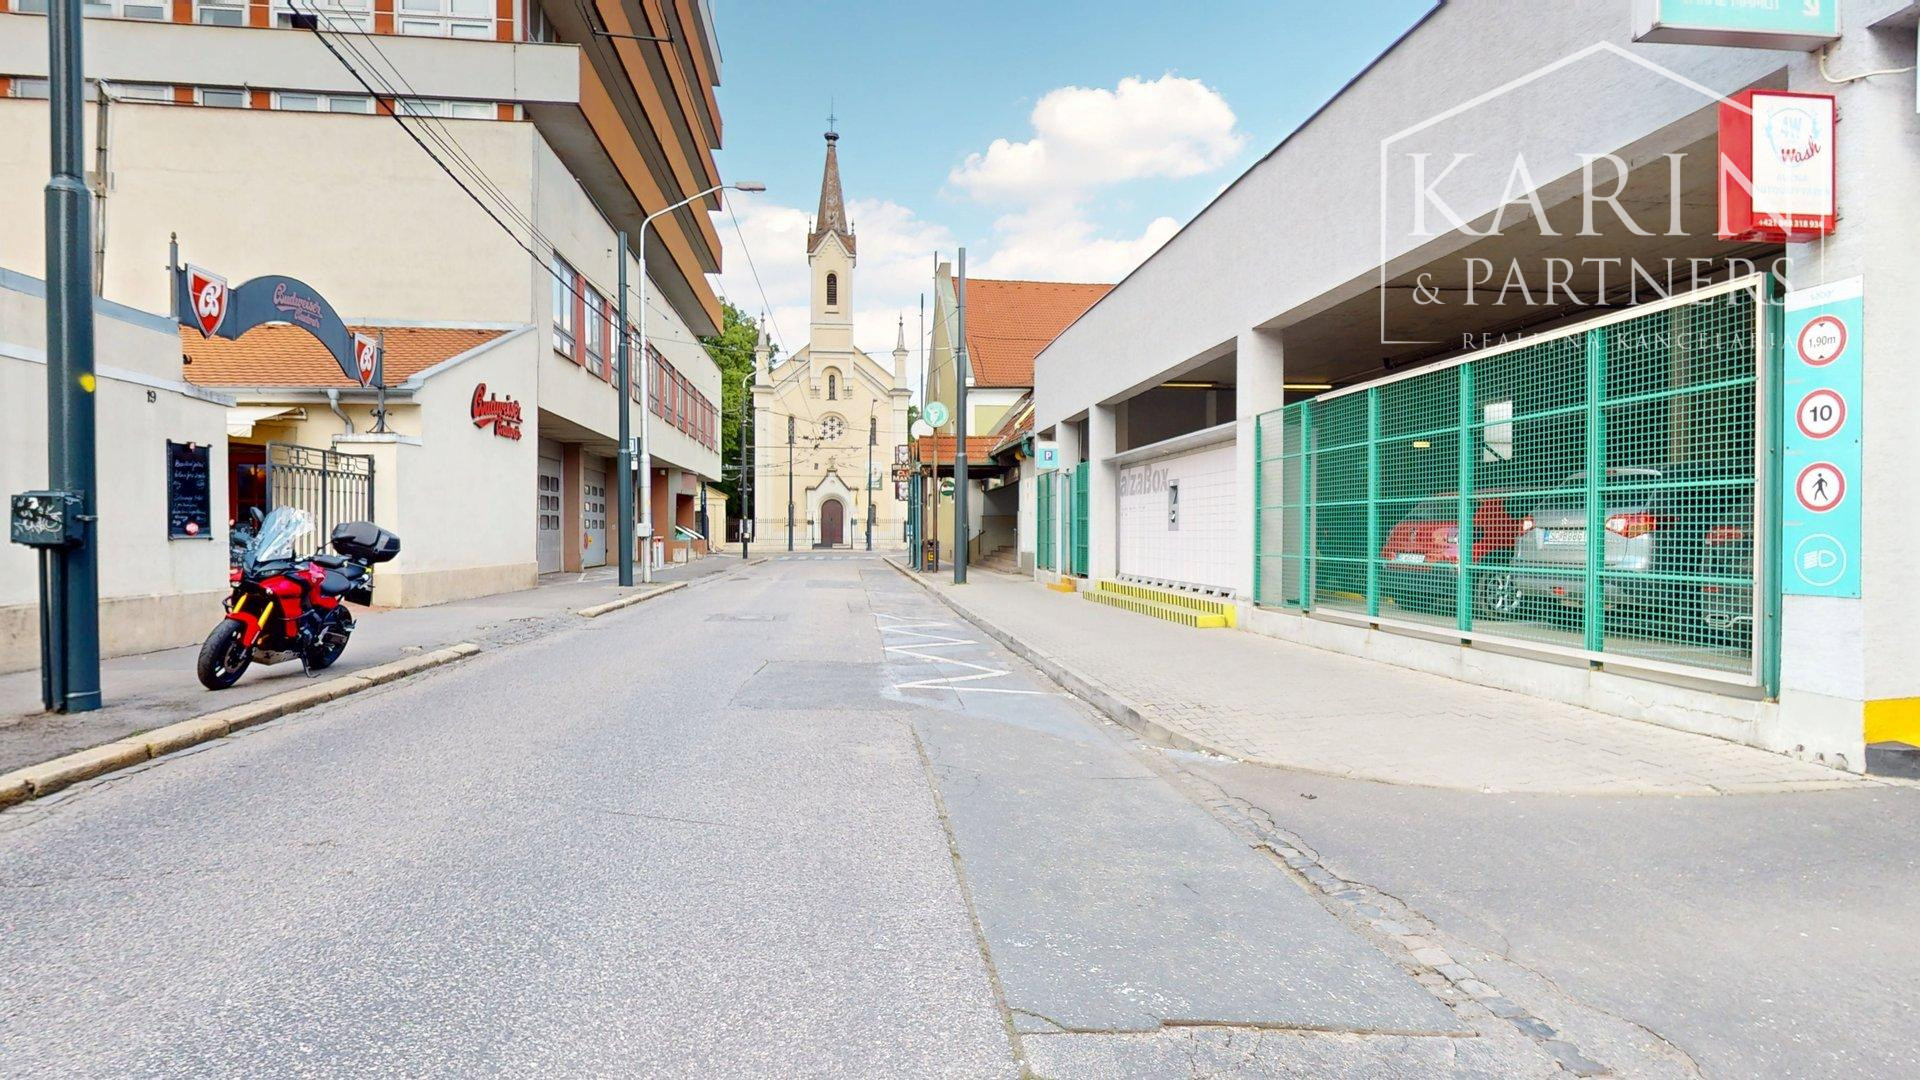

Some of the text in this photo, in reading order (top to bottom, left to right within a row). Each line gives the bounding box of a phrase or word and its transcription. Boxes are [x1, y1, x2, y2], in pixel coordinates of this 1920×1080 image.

[1808, 335, 1836, 349] 1,90m
[147, 390, 157, 403] 19
[1809, 405, 1832, 422] 10
